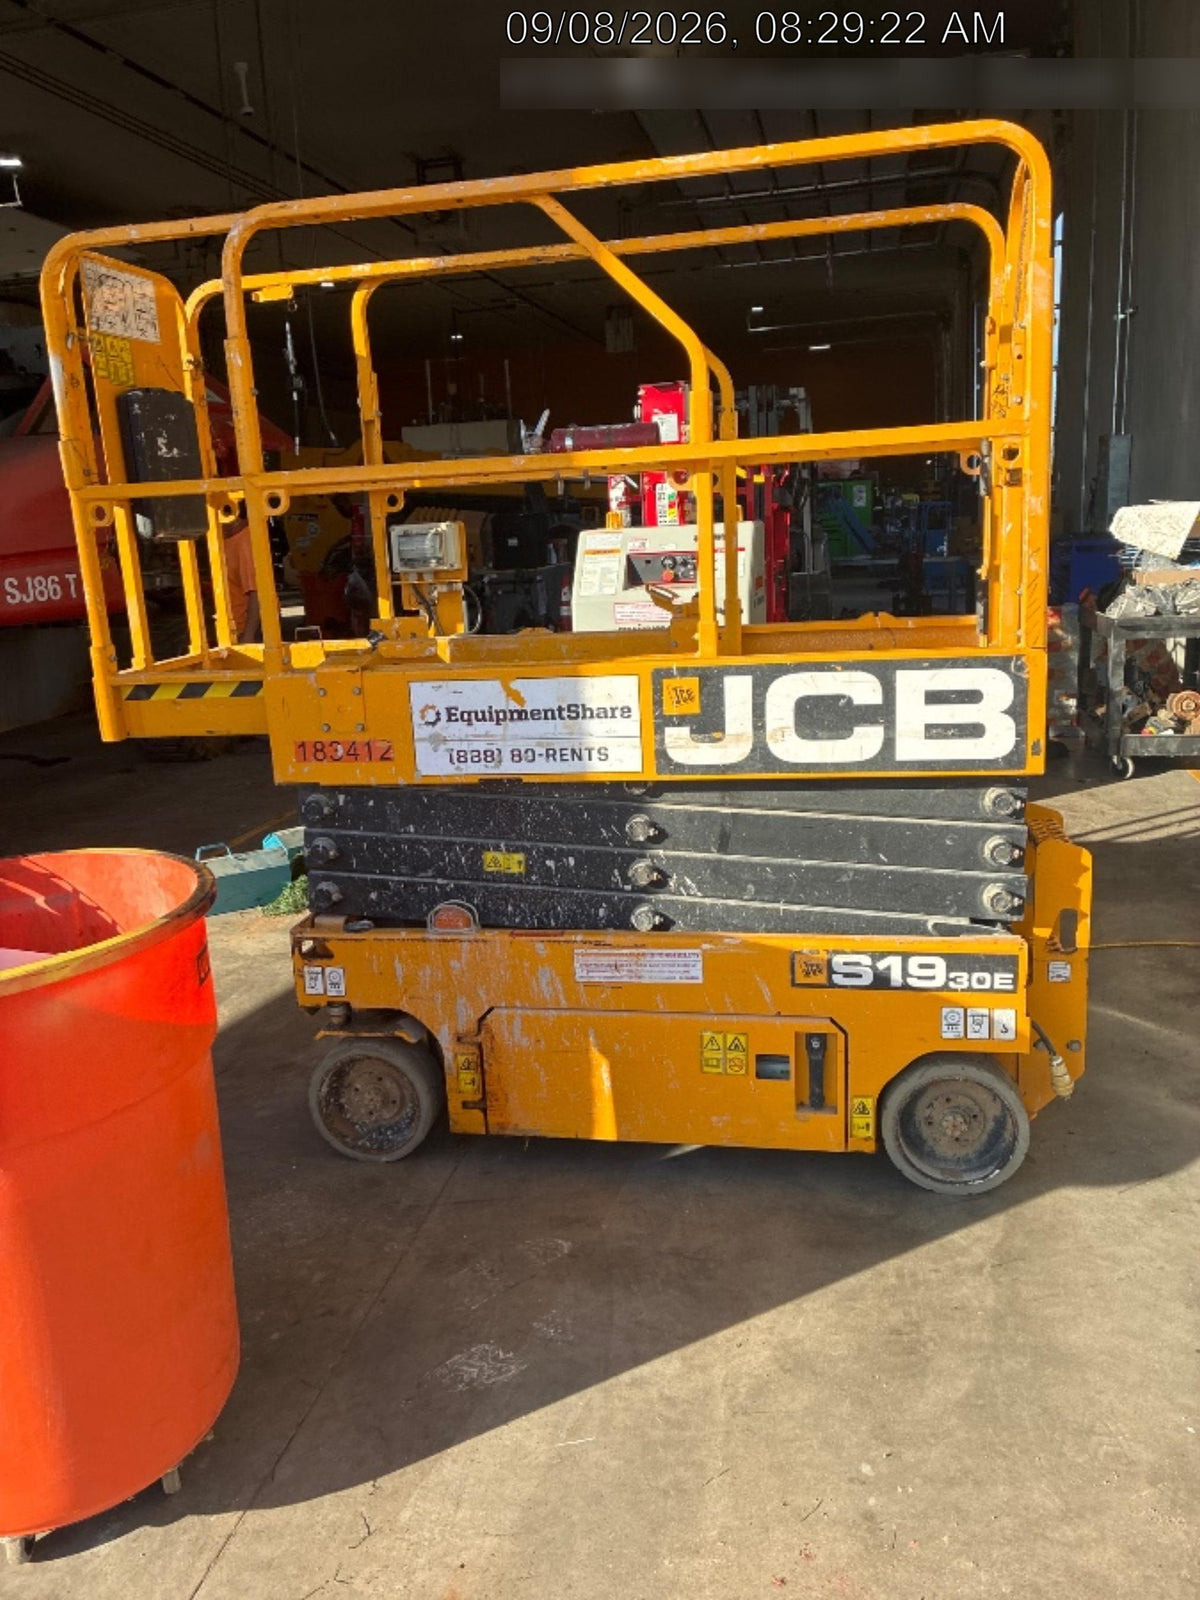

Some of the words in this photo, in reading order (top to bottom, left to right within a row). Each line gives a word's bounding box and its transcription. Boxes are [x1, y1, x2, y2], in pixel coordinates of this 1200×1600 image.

[4, 575, 62, 604] SJ86
[445, 703, 633, 726] EquipmentShare
[664, 667, 1017, 765] JCB
[297, 739, 393, 762] 183412
[449, 748, 502, 766] (888)
[510, 747, 610, 764] 80-RENTS
